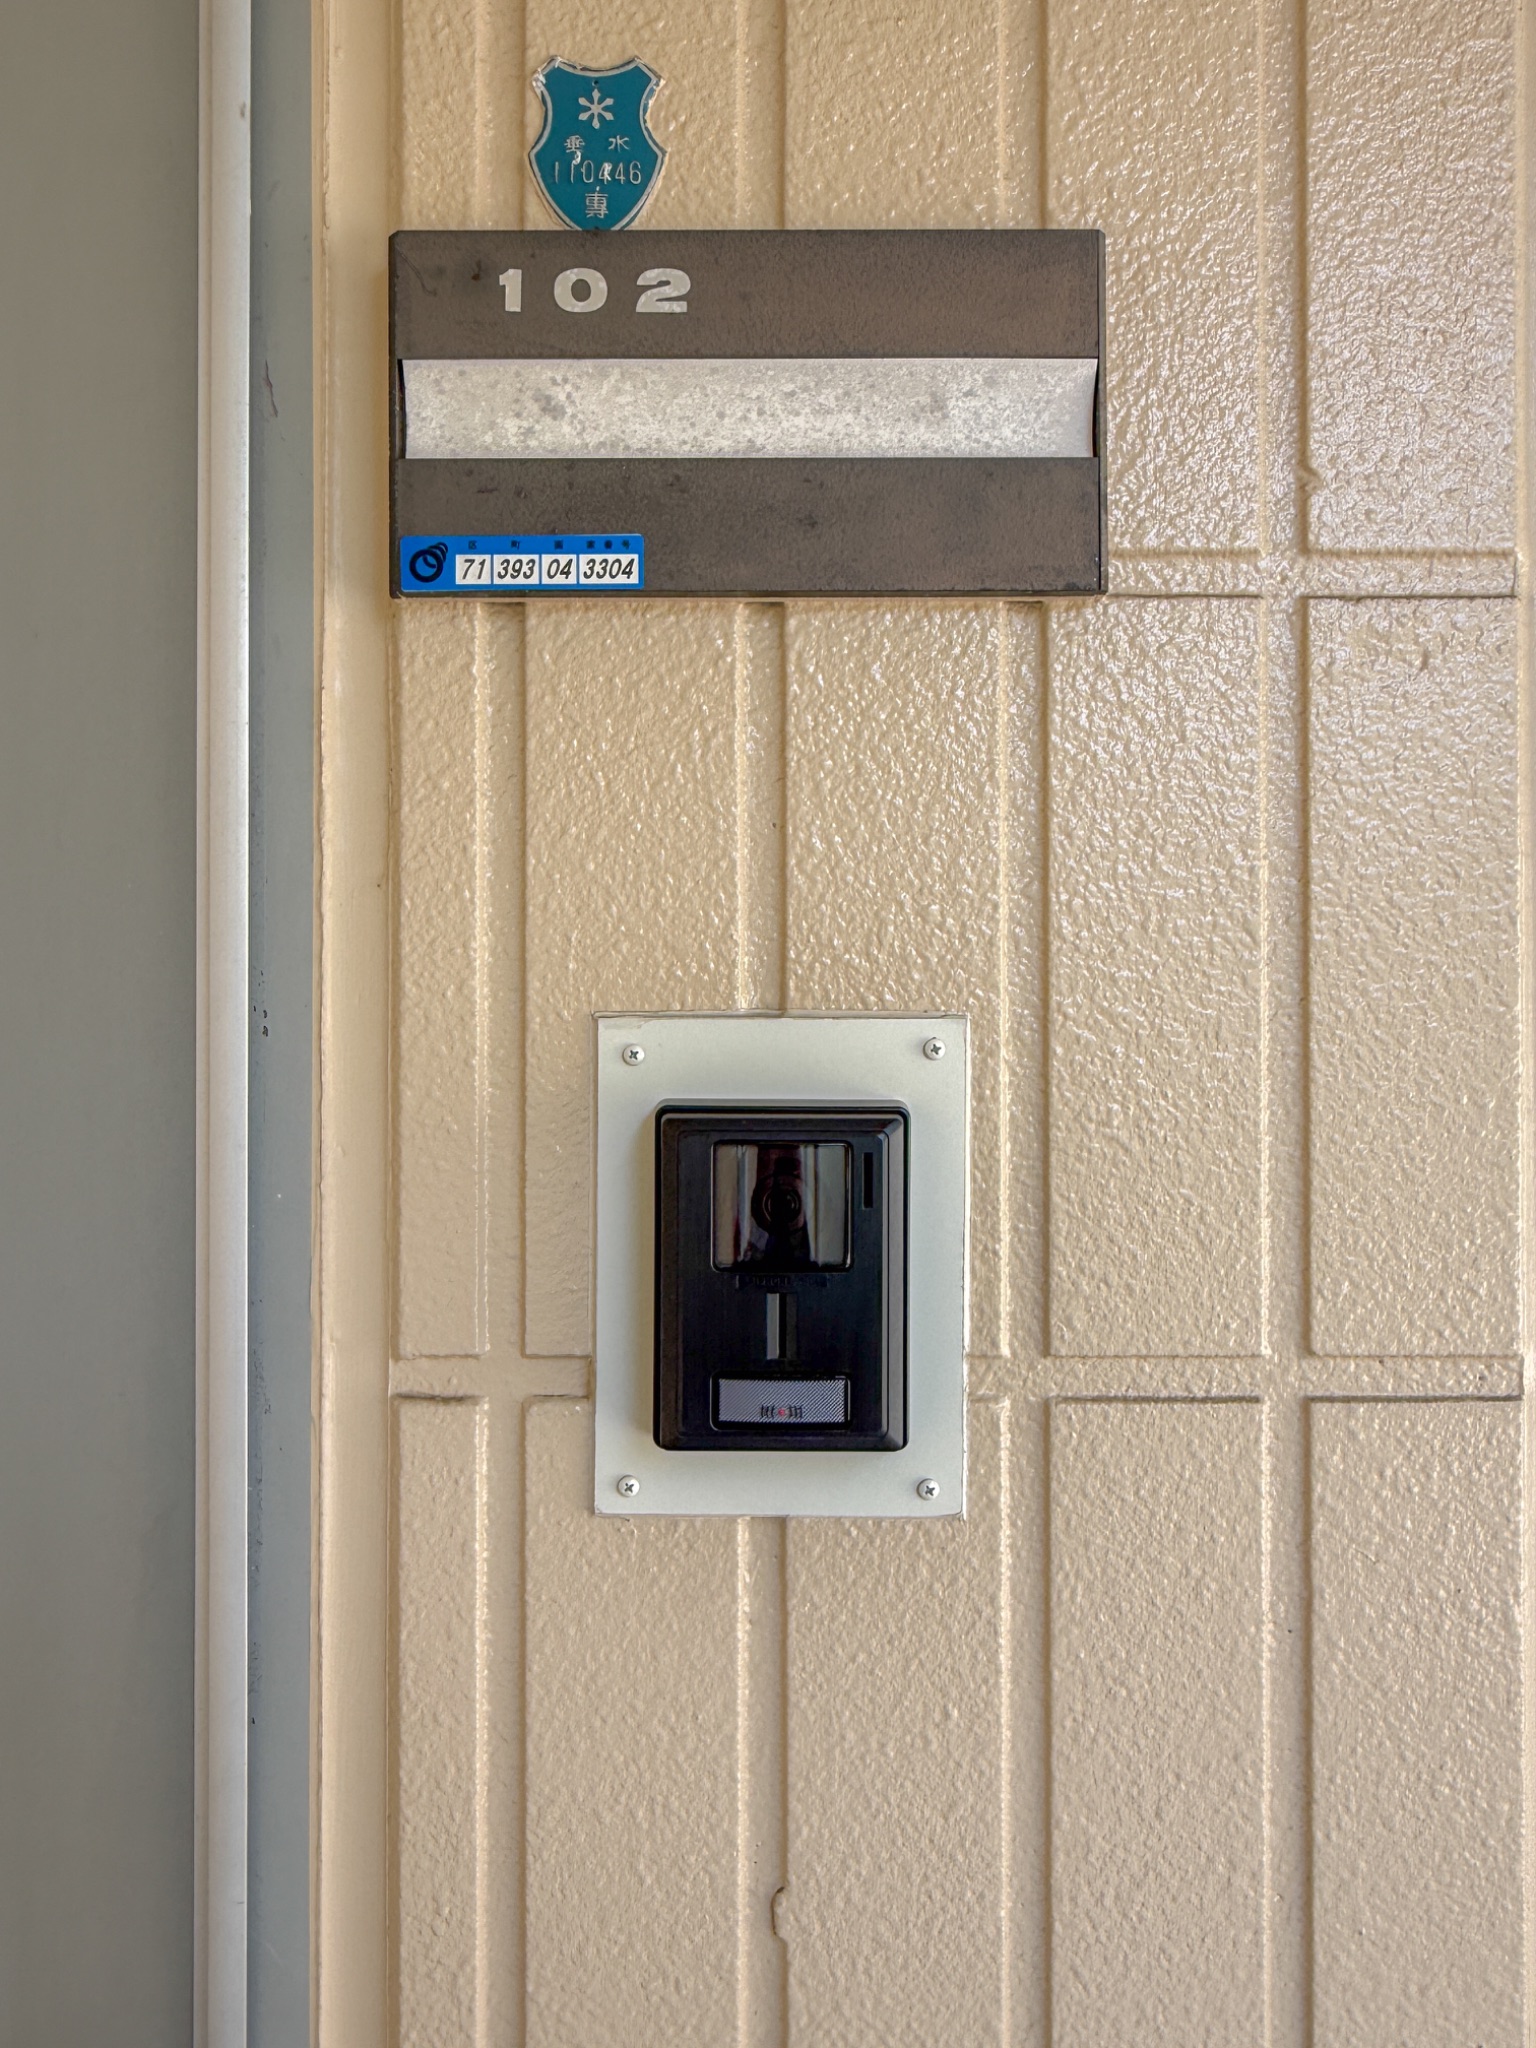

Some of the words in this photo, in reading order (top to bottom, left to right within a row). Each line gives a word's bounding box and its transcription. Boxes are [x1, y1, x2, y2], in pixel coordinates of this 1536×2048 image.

[554, 160, 642, 185] 110446
[499, 267, 692, 313] 102
[462, 558, 487, 580] 71
[497, 558, 537, 580] 393
[547, 558, 574, 580] 04
[583, 558, 636, 580] 3304
